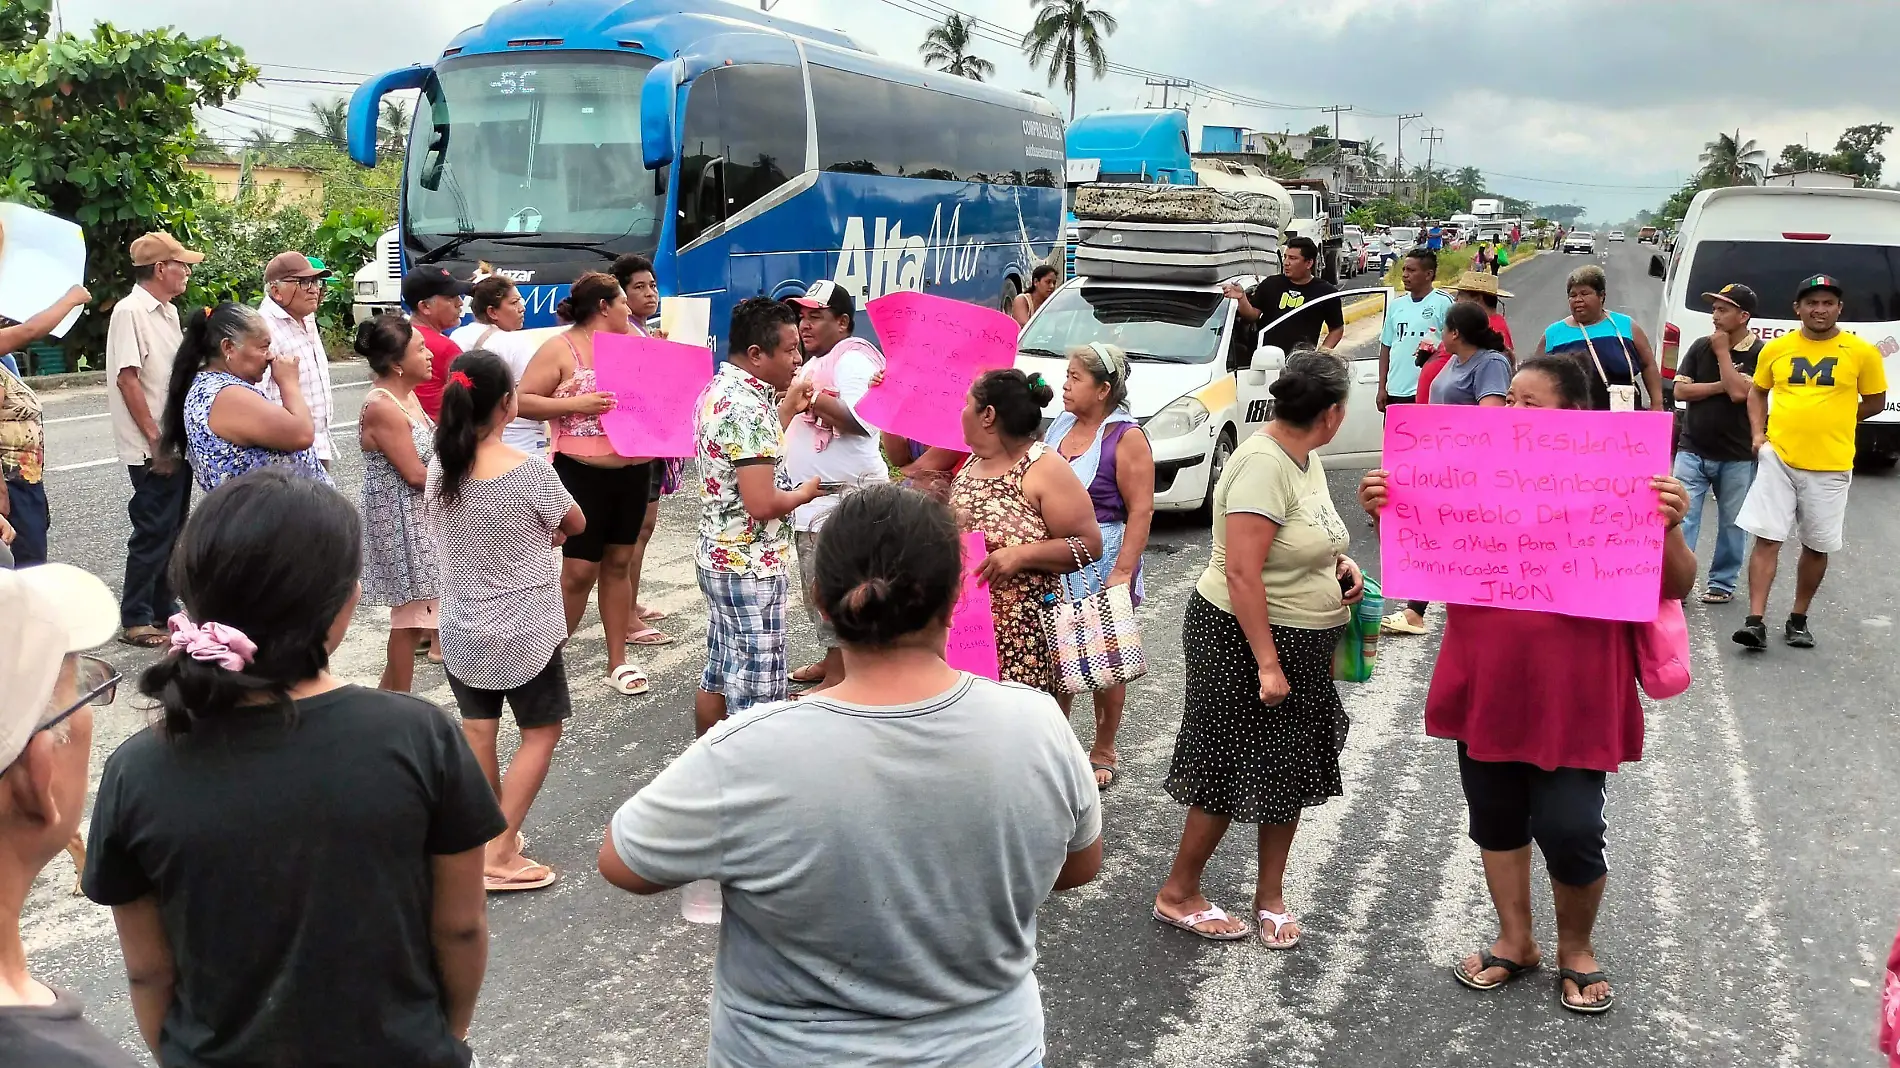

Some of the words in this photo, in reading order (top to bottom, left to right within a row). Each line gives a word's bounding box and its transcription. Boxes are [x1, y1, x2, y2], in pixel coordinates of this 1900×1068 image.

[833, 216, 926, 311] Alta
[707, 334, 717, 352] 81
[1788, 357, 1838, 386] M
[1394, 422, 1491, 451] Señora
[1512, 424, 1651, 458] Presidenta
[1394, 463, 1477, 489] Claudia
[1396, 502, 1421, 525] el
[1438, 502, 1522, 527] Pueblo
[1537, 502, 1569, 525] Del
[1396, 527, 1441, 551] Pide
[1562, 559, 1578, 578] el
[1471, 581, 1554, 602] JHON
